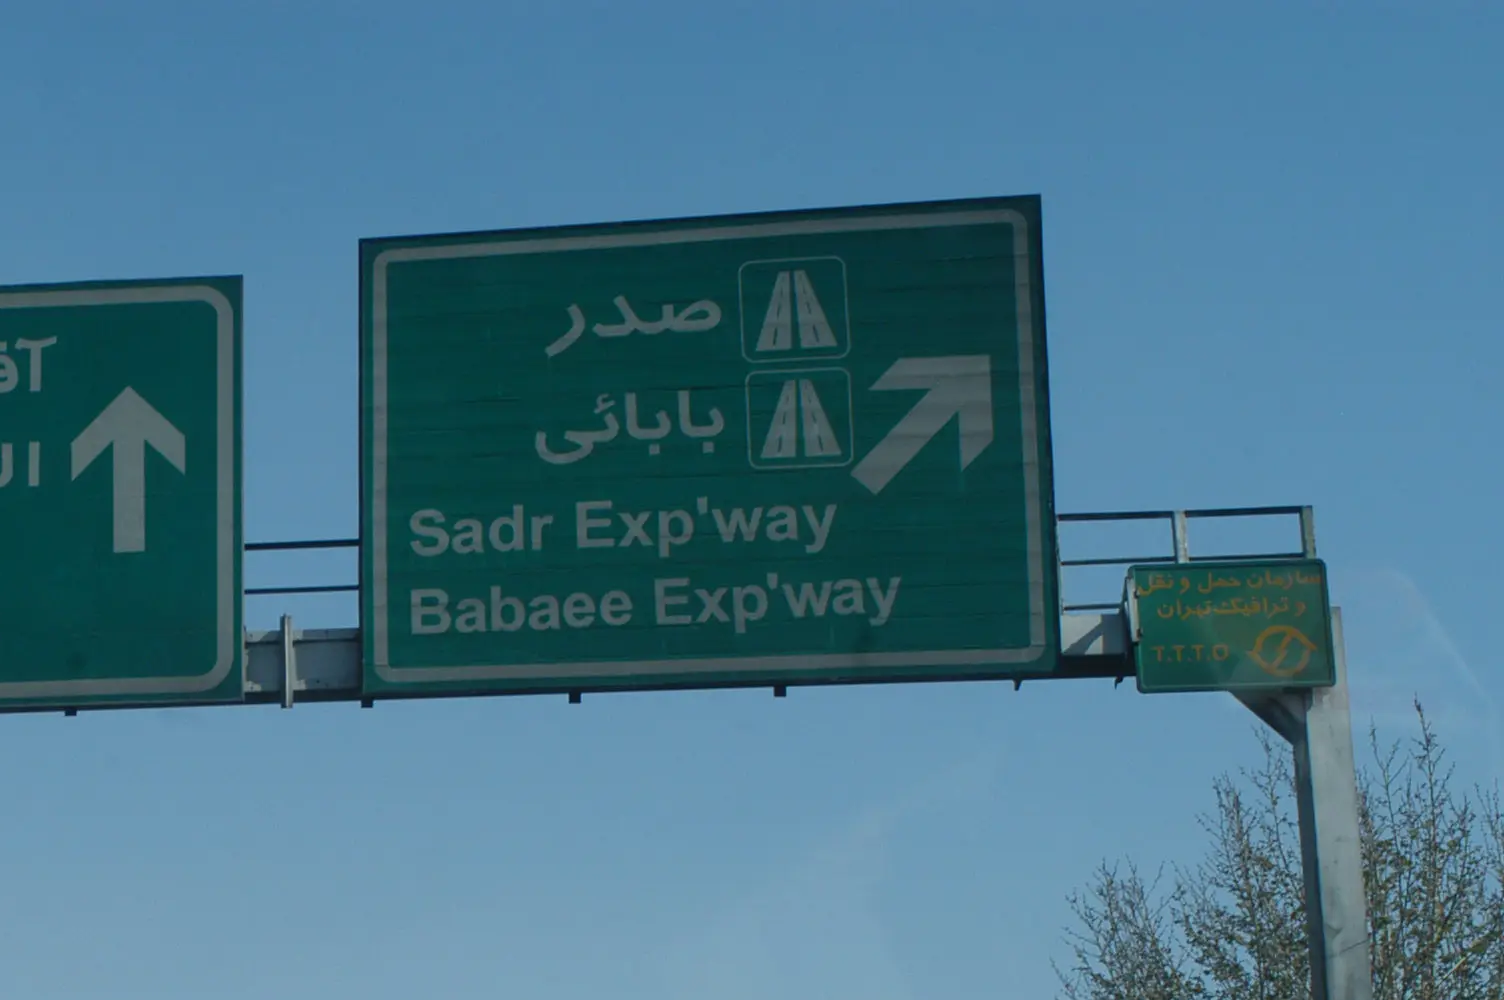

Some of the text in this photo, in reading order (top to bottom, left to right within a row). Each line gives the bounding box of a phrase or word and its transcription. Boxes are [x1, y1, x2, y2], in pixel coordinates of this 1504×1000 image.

[546, 296, 721, 357] صدر
[409, 497, 837, 558] Sadr Exp'way
[1138, 573, 1174, 596] نقل
[1198, 572, 1242, 594] حمل
[1247, 569, 1322, 590] سازمان
[410, 573, 902, 635] Babaee Exp'way
[1157, 599, 1213, 620] تهران
